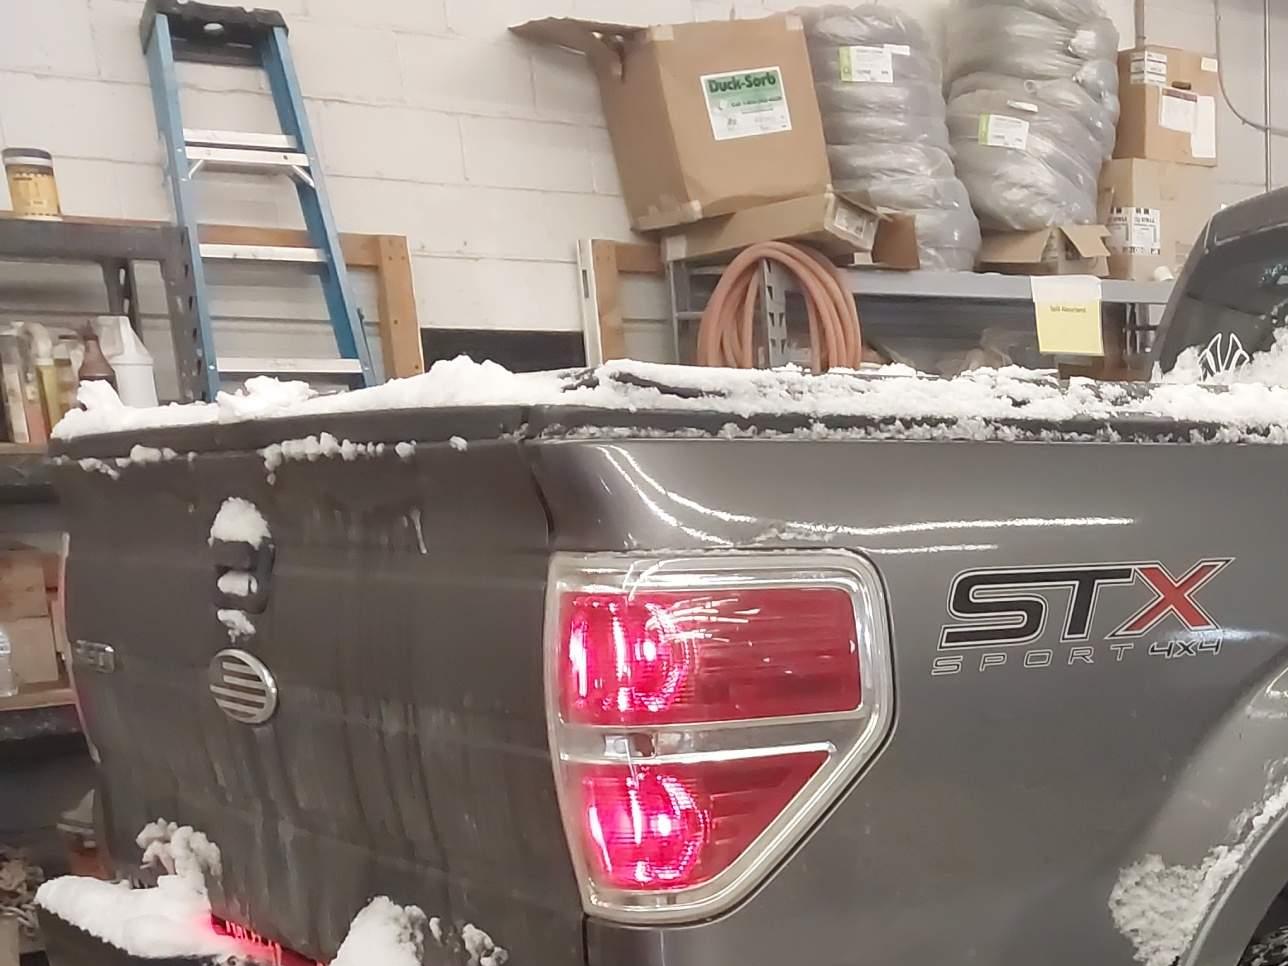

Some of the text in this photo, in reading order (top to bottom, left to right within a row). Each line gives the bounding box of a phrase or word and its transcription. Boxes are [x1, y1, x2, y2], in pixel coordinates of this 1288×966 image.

[708, 72, 776, 93] Duck-Sorb
[937, 557, 1236, 651] STX
[931, 643, 1134, 675] SPORT
